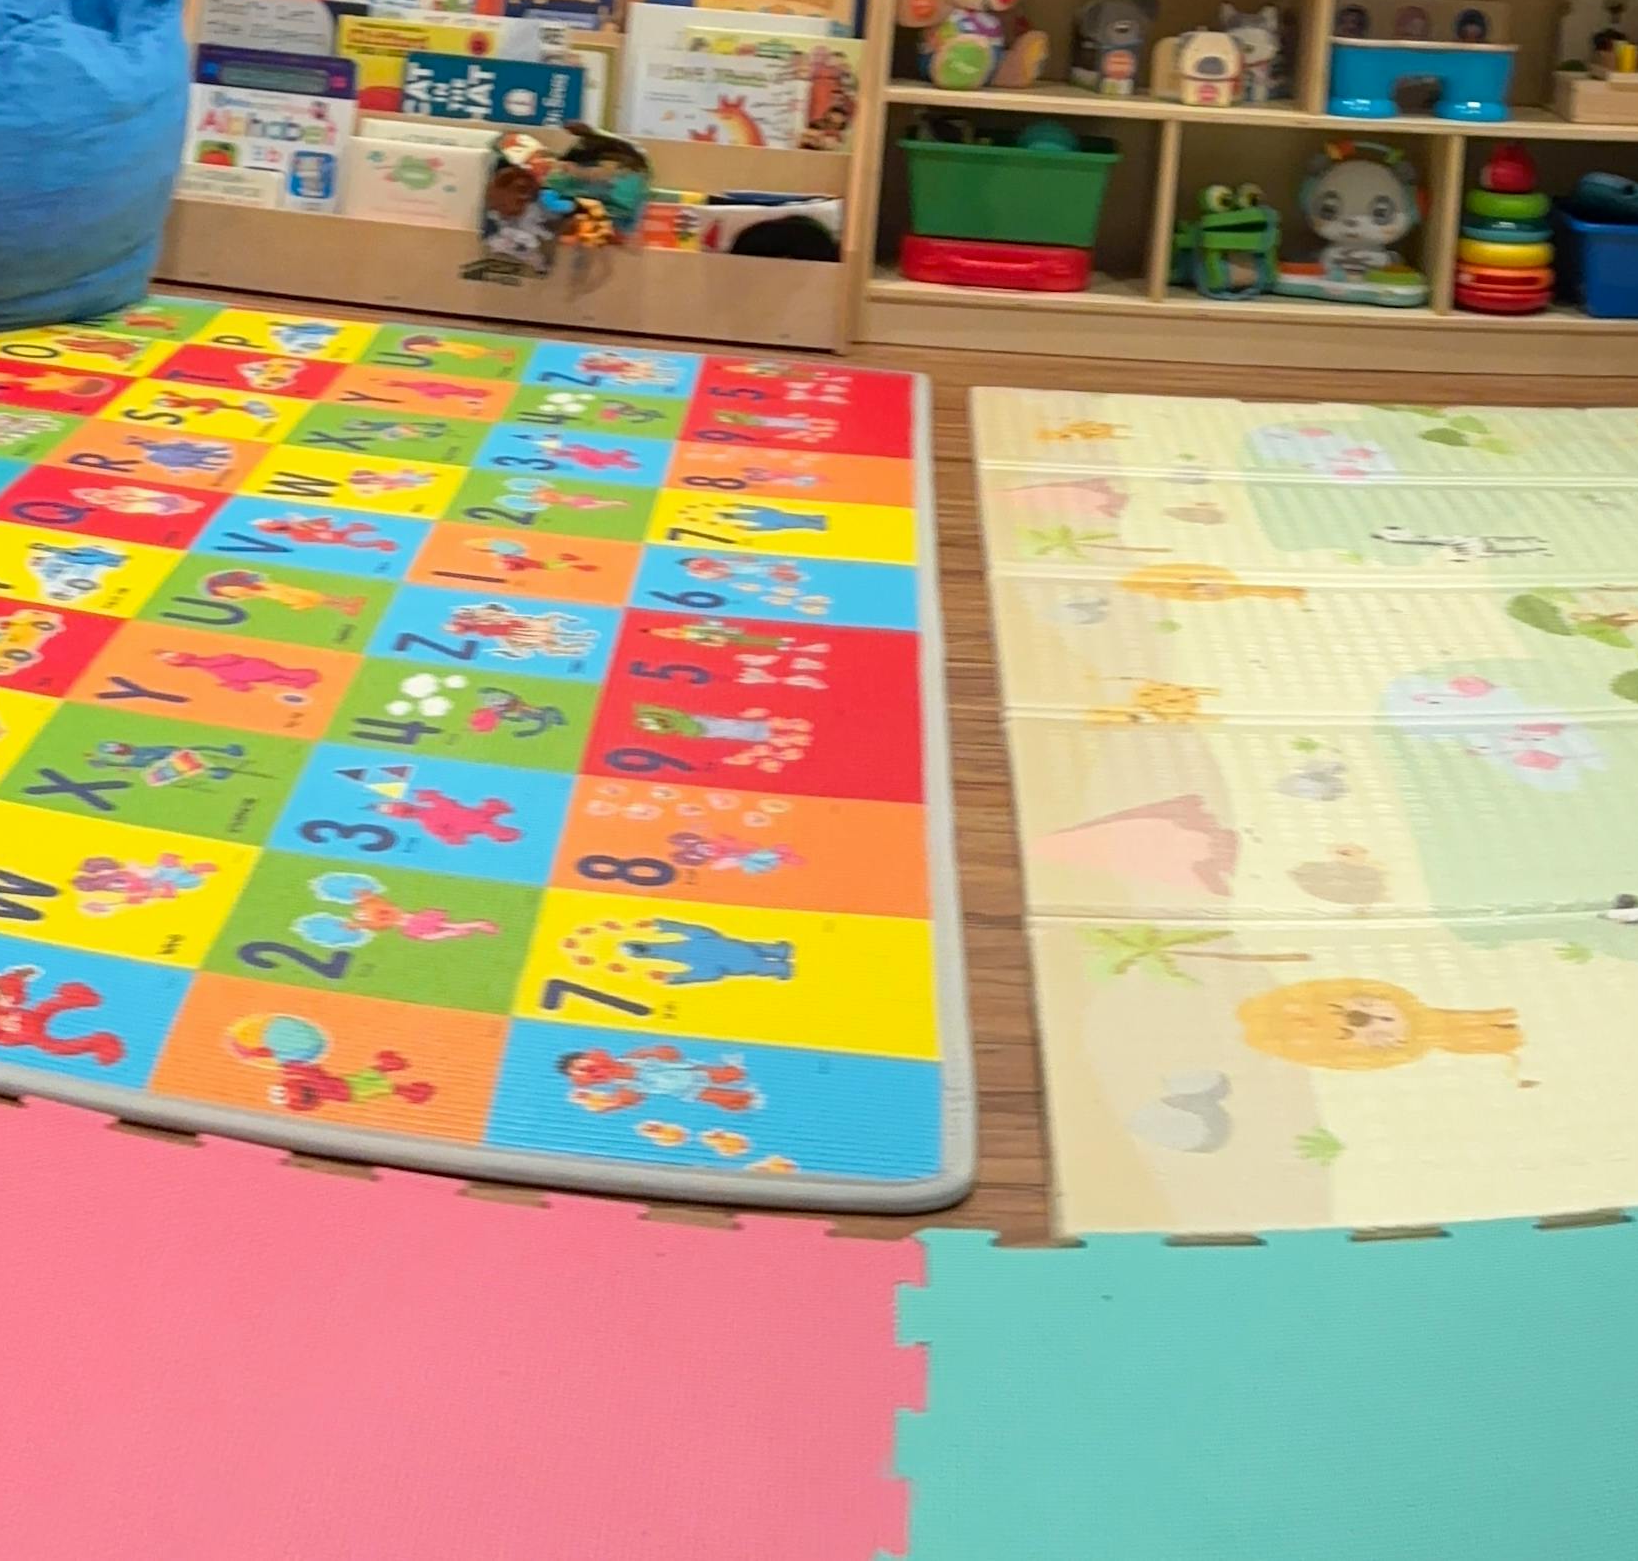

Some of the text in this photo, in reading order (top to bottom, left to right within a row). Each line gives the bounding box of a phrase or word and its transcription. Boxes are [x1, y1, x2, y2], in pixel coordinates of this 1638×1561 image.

[0, 342, 61, 360] O
[123, 408, 187, 428] S
[68, 450, 144, 474] R
[493, 455, 559, 472] 3
[260, 471, 343, 498] W
[681, 473, 750, 492] 8
[10, 500, 93, 525] Q
[464, 504, 535, 526] 2
[214, 530, 295, 555] V
[665, 525, 741, 545] 7
[159, 594, 251, 628] U
[649, 589, 728, 610] 6
[391, 632, 480, 662] Z
[630, 660, 714, 686] 5
[94, 675, 191, 705] Y
[350, 716, 443, 746] 4
[604, 747, 699, 773] 9
[22, 767, 132, 813] X
[296, 818, 400, 854] 3
[575, 853, 678, 888] 8
[236, 940, 353, 981] 2
[540, 977, 653, 1018] 7
